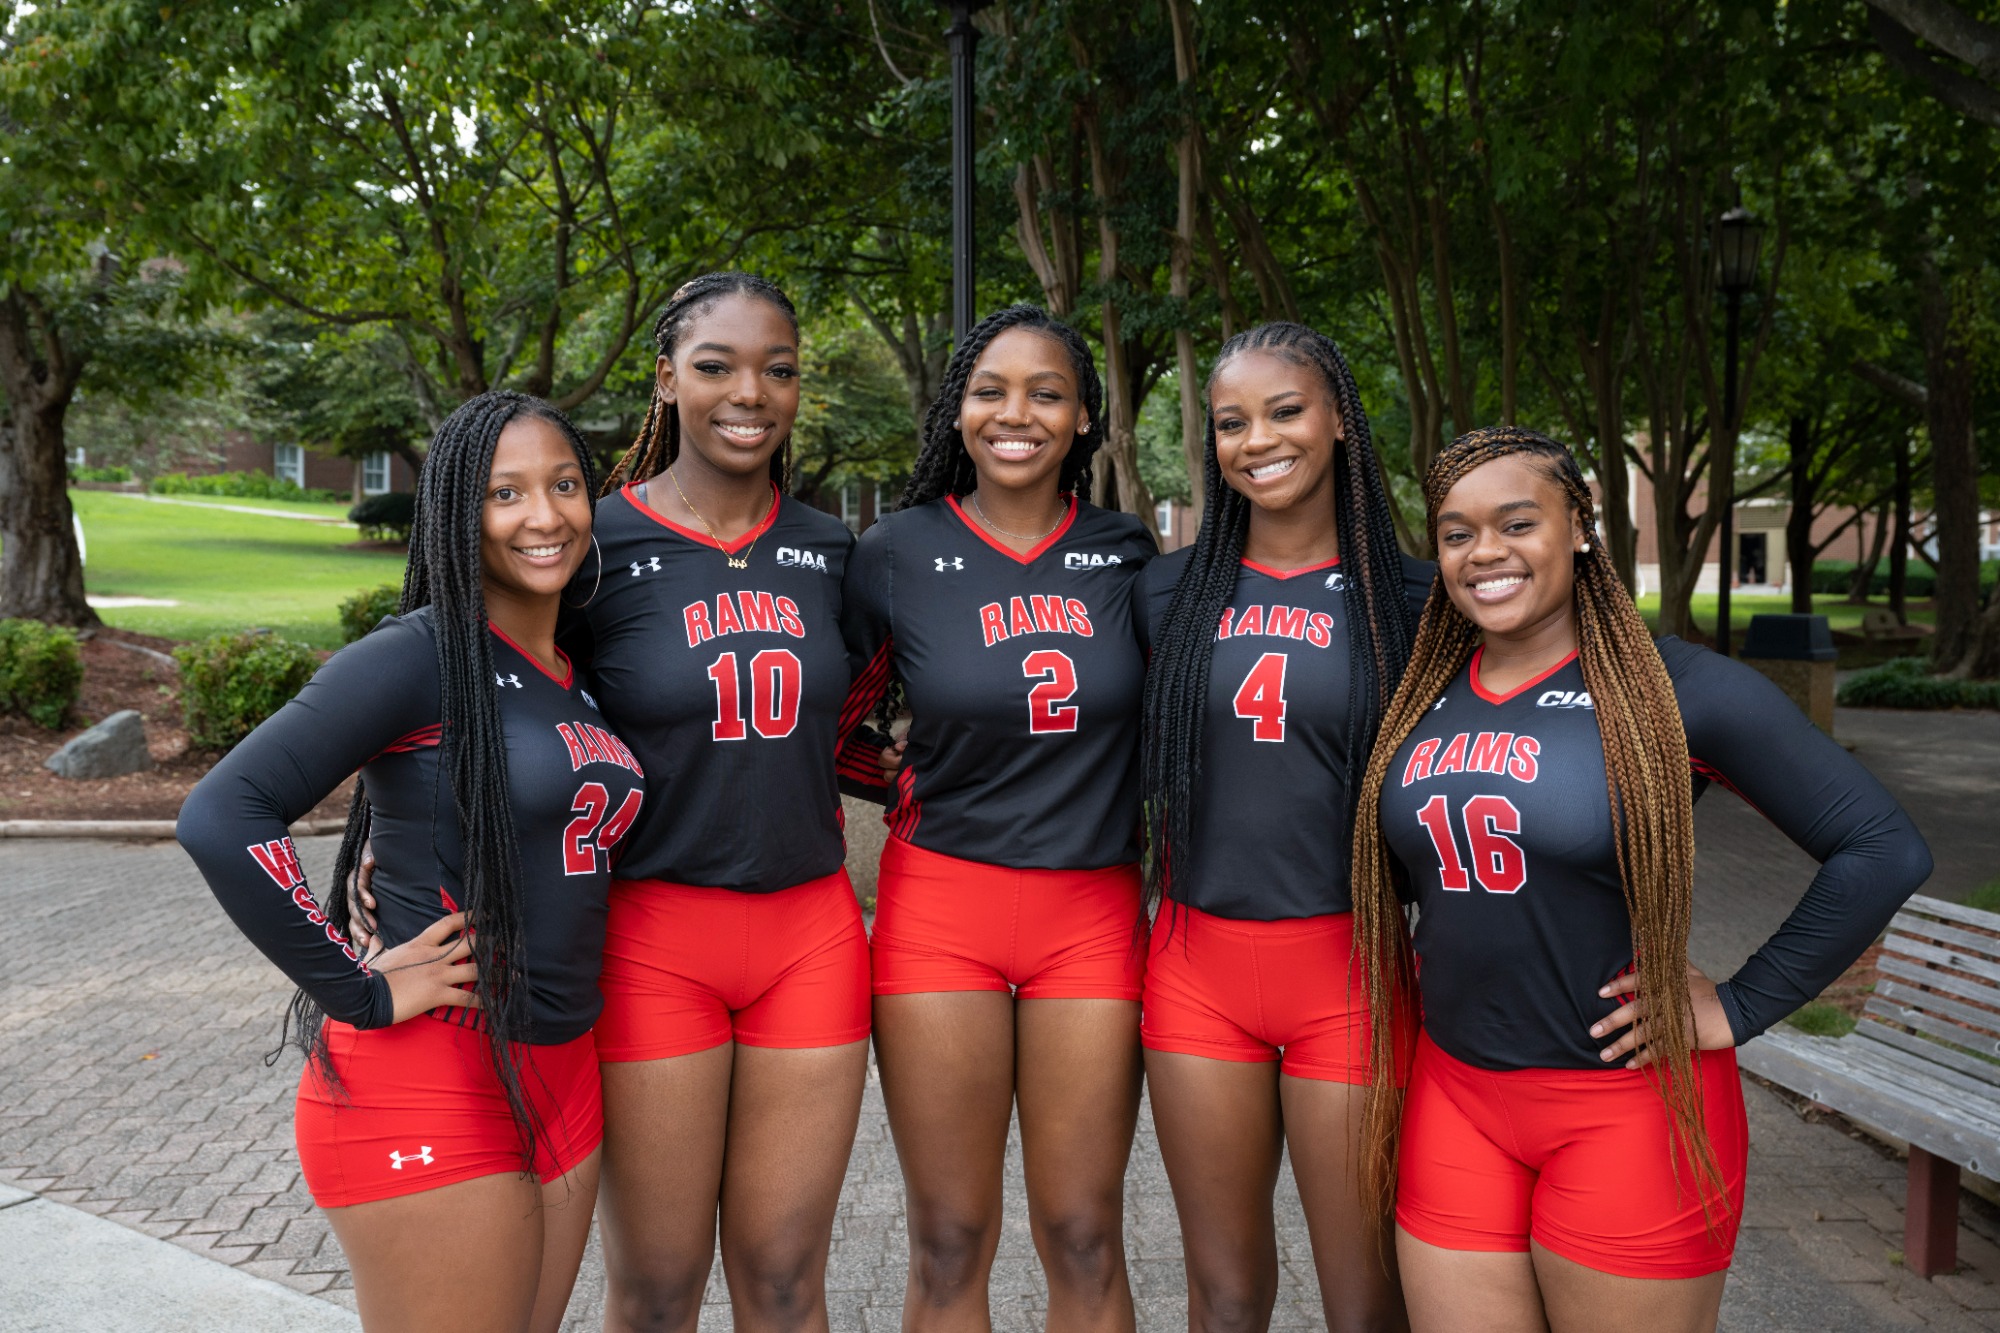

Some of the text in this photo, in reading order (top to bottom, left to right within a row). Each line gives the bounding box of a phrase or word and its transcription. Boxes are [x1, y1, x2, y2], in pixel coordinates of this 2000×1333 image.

[776, 547, 829, 574] CIAA
[1065, 552, 1123, 571] CIAA
[683, 590, 806, 648] RAMS
[979, 594, 1094, 648] RAMS
[706, 649, 803, 742] 10
[1021, 649, 1079, 735] 2
[1232, 652, 1289, 743] 4
[1535, 690, 1595, 710] CIA
[555, 721, 645, 779] RAMS
[1401, 731, 1542, 788] RAMS
[562, 782, 644, 877] 24
[1416, 795, 1527, 895] 16
